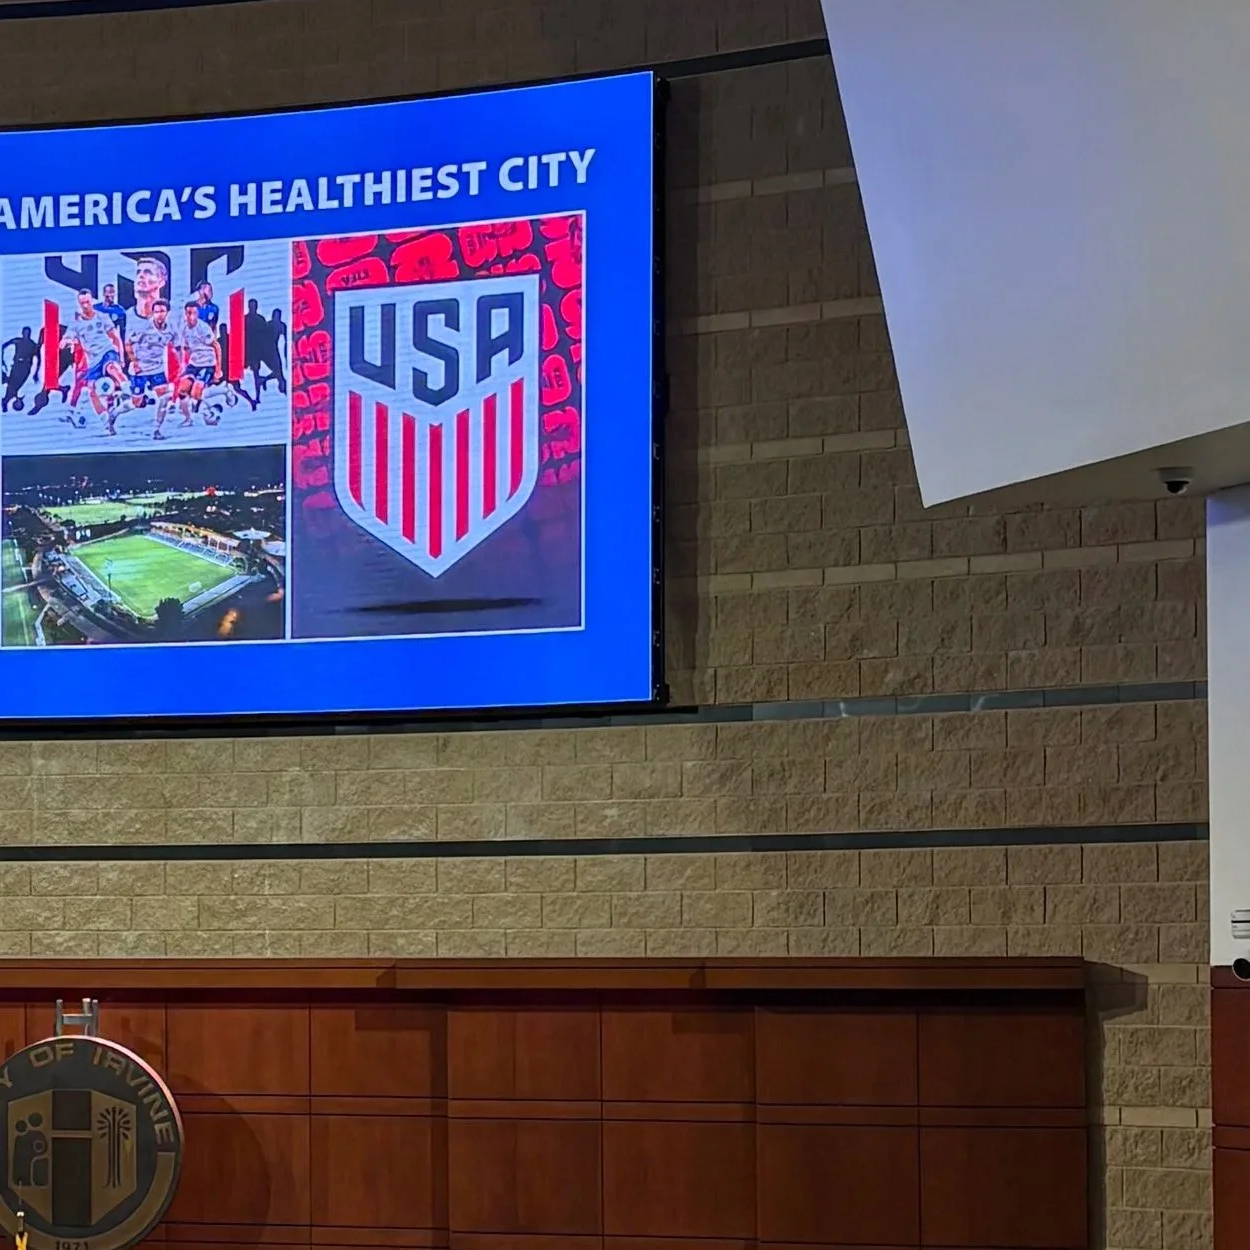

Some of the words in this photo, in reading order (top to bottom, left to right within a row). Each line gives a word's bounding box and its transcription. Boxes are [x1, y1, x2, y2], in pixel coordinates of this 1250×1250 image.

[229, 161, 488, 216] HEALTHIEST
[498, 148, 597, 191] CITY
[349, 291, 525, 407] USA
[29, 1042, 75, 1068] OF
[92, 1047, 176, 1145] IRVINE
